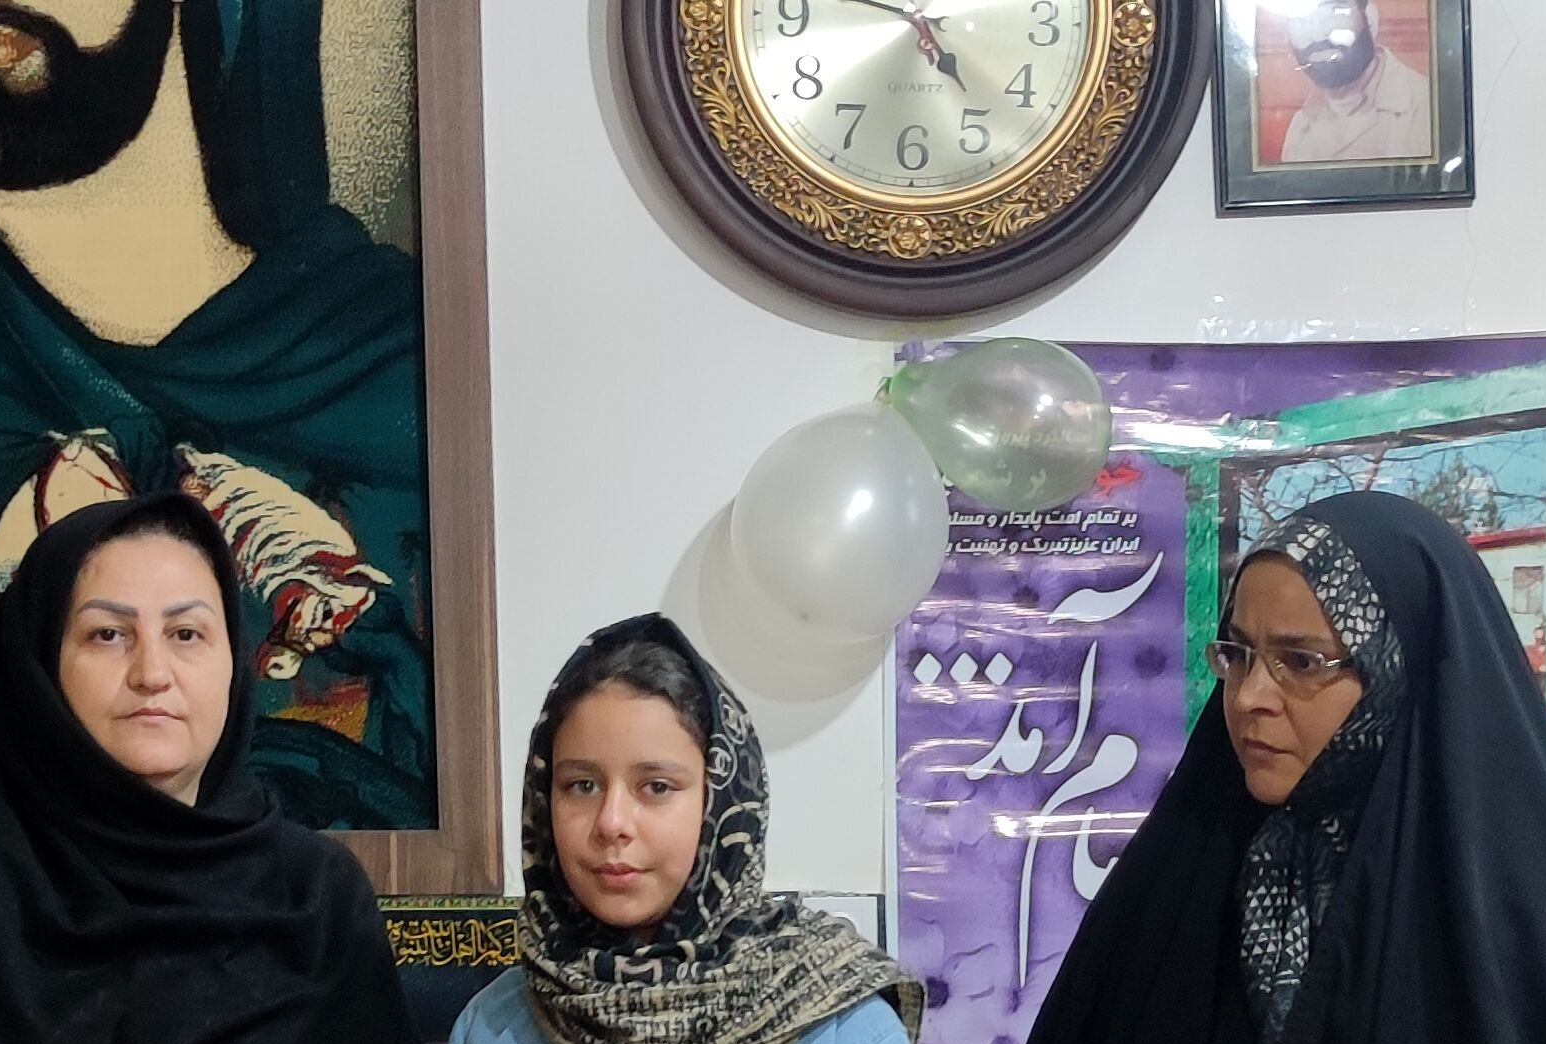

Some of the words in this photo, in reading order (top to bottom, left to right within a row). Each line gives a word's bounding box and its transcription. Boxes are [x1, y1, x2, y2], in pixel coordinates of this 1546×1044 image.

[778, 0, 810, 37] 9
[1028, 0, 1060, 46] 3
[792, 55, 823, 100] 8
[887, 82, 944, 94] QUARTZ
[1004, 63, 1037, 108] 4
[835, 103, 867, 150] 7
[958, 108, 991, 154] 5
[896, 125, 929, 171] 6
[987, 514, 998, 528] و
[999, 510, 1043, 532] پایدار
[1044, 510, 1082, 525] امت
[1081, 510, 1122, 532] تمام
[1120, 513, 1138, 528] بر
[955, 537, 1009, 556] تهنیت
[1008, 541, 1020, 556] و
[1100, 536, 1141, 555] ایران
